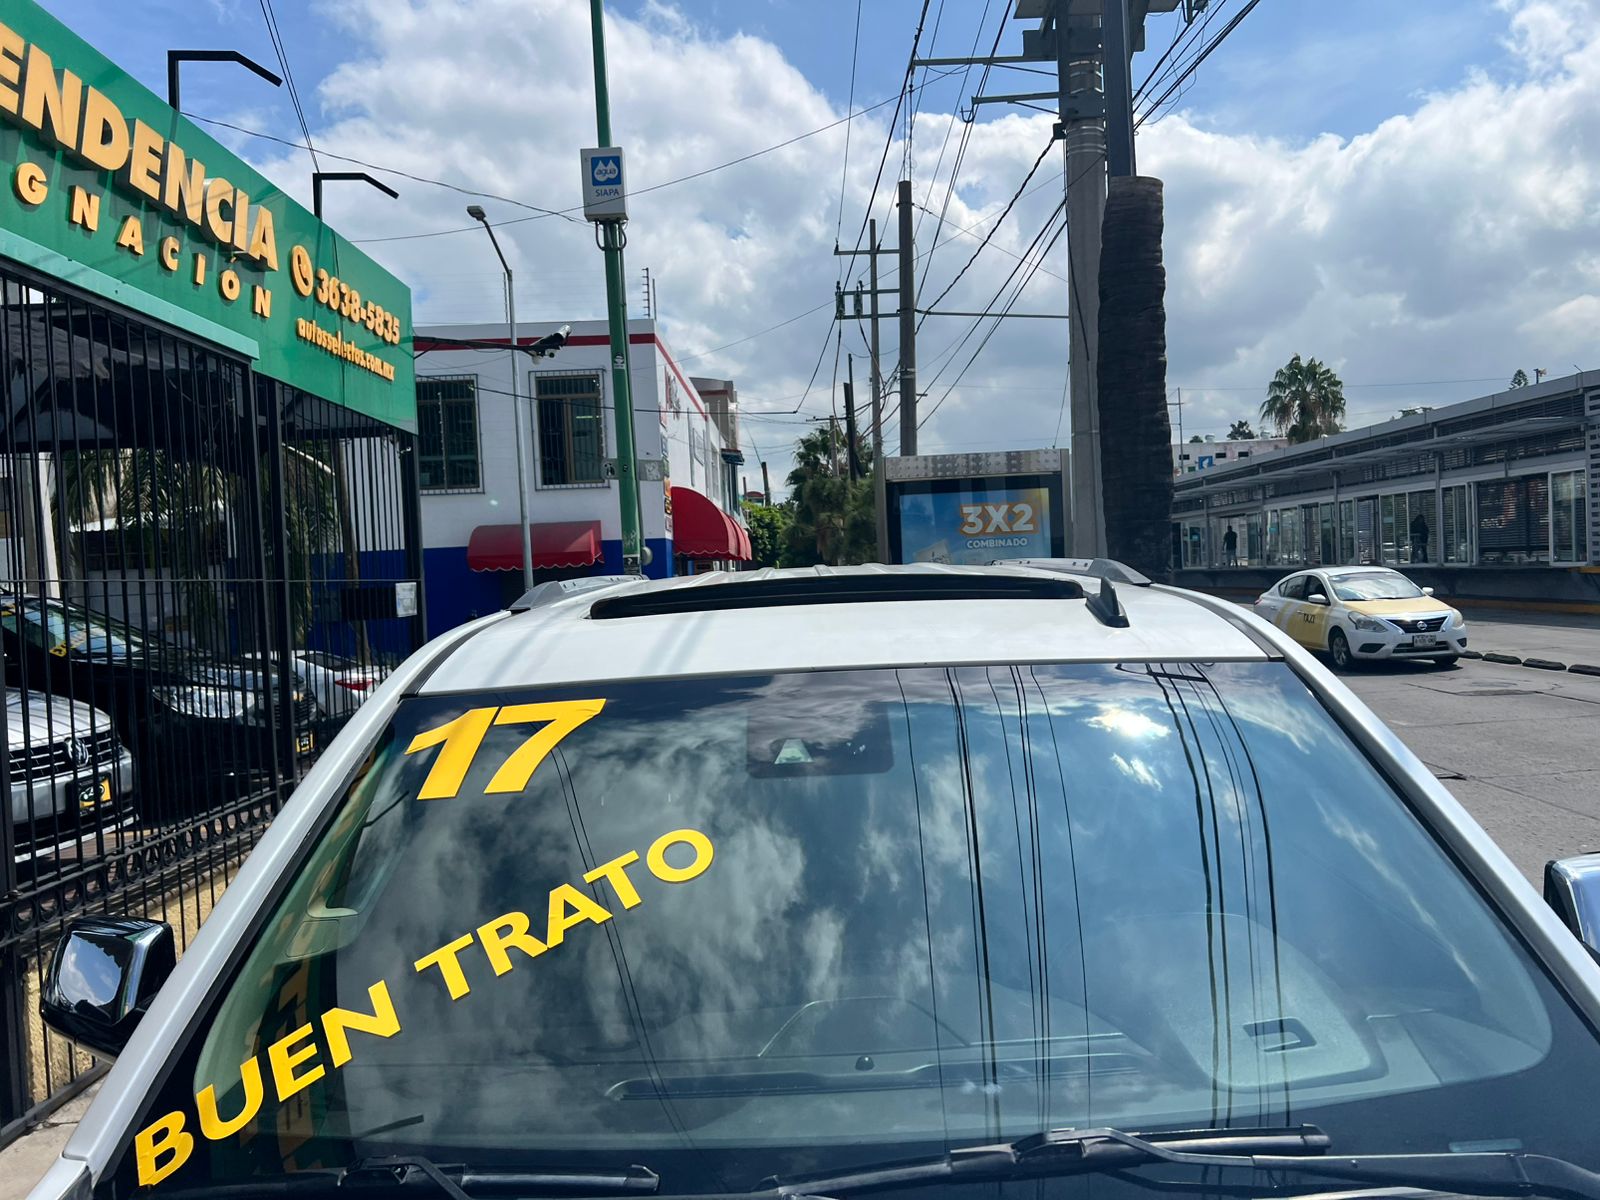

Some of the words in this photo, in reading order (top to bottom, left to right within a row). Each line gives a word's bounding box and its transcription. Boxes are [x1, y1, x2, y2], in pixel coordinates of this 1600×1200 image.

[595, 189, 619, 197] SIAPA
[316, 268, 400, 345] 3638-5835
[962, 503, 1034, 534] 3X2
[966, 537, 1028, 549] COMBINADO
[404, 698, 607, 800] 17
[135, 979, 401, 1186] BUEN
[414, 829, 714, 1000] TRATO
